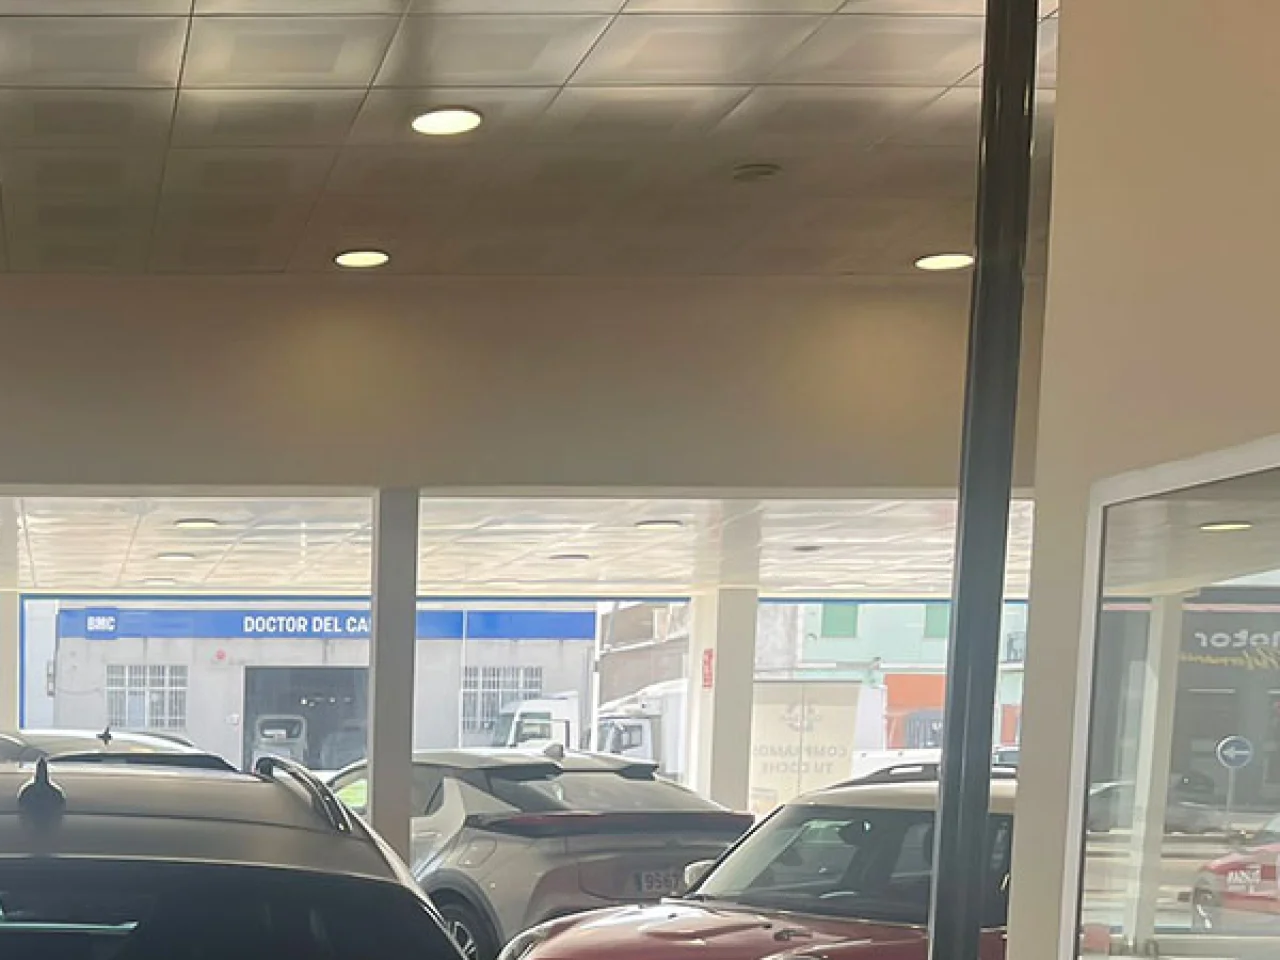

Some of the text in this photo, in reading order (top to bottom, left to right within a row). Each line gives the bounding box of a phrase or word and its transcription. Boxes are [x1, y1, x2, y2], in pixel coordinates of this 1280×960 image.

[244, 616, 372, 632] DOCTOR DEL CA
